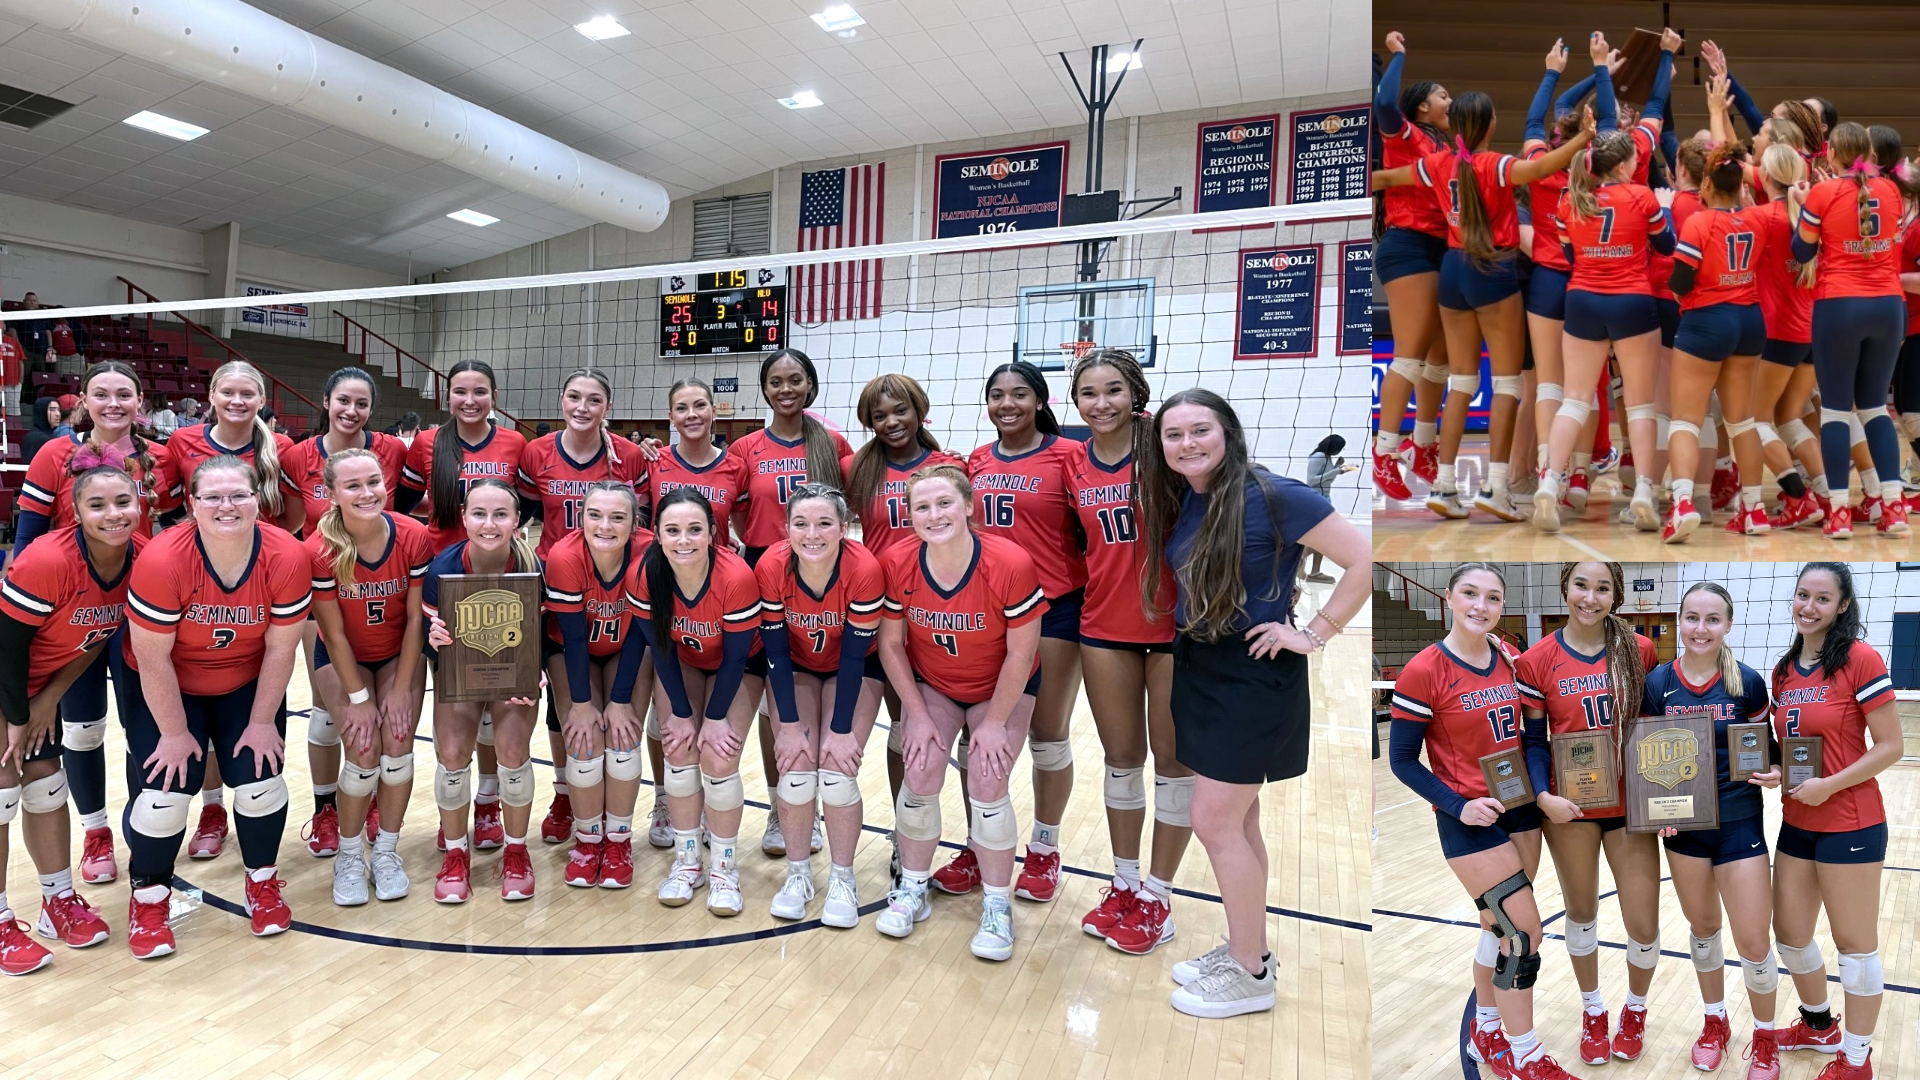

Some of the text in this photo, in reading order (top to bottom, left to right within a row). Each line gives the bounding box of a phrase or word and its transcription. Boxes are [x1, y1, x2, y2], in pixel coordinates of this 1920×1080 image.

[1298, 116, 1368, 132] SEMINOLE
[1205, 126, 1272, 142] SEMINOLE
[1298, 146, 1364, 160] CONFERENCE
[1310, 140, 1353, 151] BI-STATE
[960, 158, 1039, 178] SEMINOLE
[1210, 154, 1264, 166] REGION II
[1296, 154, 1366, 168] CHAMPIONS
[1204, 162, 1270, 176] CHAMPIONS
[1298, 166, 1364, 178] 1975 1976 1977
[969, 180, 1030, 191] Women's Basketball
[1228, 178, 1244, 186] 1975
[1250, 176, 1268, 184] 1976
[1296, 186, 1314, 194] 1992
[1345, 181, 1364, 189] 1996
[1297, 174, 1364, 186] 1978 1990 1991
[1204, 184, 1268, 196] 1977 1978 1997
[1296, 193, 1315, 201] 1997
[1345, 188, 1364, 196] 1999
[977, 193, 1019, 208] NJCAA
[940, 201, 1058, 221] NATIONAL CHAMPIONS
[978, 221, 1018, 236] 1976
[1598, 206, 1615, 244] 7
[1726, 232, 1754, 272] 17
[1246, 255, 1315, 269] SEMINOLE
[1266, 279, 1292, 289] 1977
[664, 294, 696, 304] SEMINOLE
[672, 306, 692, 324] 25
[718, 304, 726, 320] 3
[762, 300, 778, 317] 14
[670, 332, 679, 346] 2
[688, 331, 696, 346] 0
[745, 328, 754, 343] 0
[768, 326, 777, 342] 0
[712, 346, 730, 354] MATCH
[1263, 340, 1288, 350] 40-3
[462, 462, 508, 476] MINOLE
[759, 458, 807, 474] SEMINO
[776, 474, 806, 504] 15
[973, 474, 1042, 493] SEMINOLE
[983, 493, 1015, 528] 16
[1097, 506, 1138, 544] 10
[338, 576, 408, 600] SEMINOLE
[69, 603, 124, 626] SEMINO
[186, 602, 266, 626] SEMINOLE
[366, 600, 386, 626] 5
[458, 603, 520, 634] NJCAA
[908, 606, 986, 632] SEMINOLE
[508, 632, 516, 642] 2
[590, 617, 621, 642] 14
[208, 628, 236, 650] 3
[807, 630, 826, 652] 7
[933, 634, 958, 656] 4
[1460, 684, 1520, 711] SEMINOLE
[1778, 686, 1829, 706] SEMINOLE
[1582, 694, 1613, 729] 10
[1487, 704, 1518, 744] 12
[1786, 708, 1801, 738] 2
[1640, 740, 1696, 770] NJCAA
[1684, 766, 1692, 775] 2
